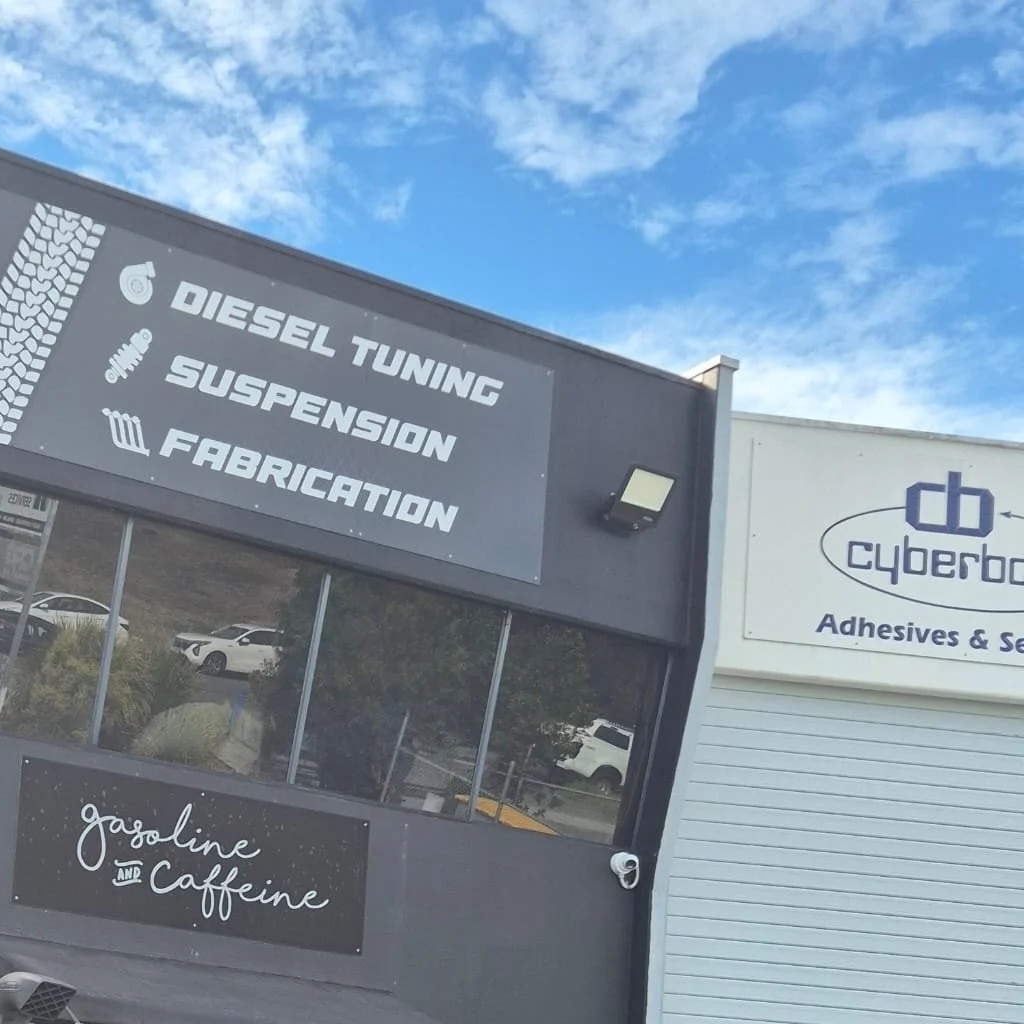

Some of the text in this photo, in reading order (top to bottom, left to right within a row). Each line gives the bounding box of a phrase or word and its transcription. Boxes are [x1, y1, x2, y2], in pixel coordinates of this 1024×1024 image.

[170, 280, 505, 407] DIESEL TUNING
[164, 354, 457, 463] SUSPENSION
[159, 427, 460, 534] FABRICATION
[815, 613, 960, 648] Adhesives
[968, 628, 989, 650] &
[76, 802, 261, 872] gasoline
[116, 859, 330, 921] AND Caffeine
